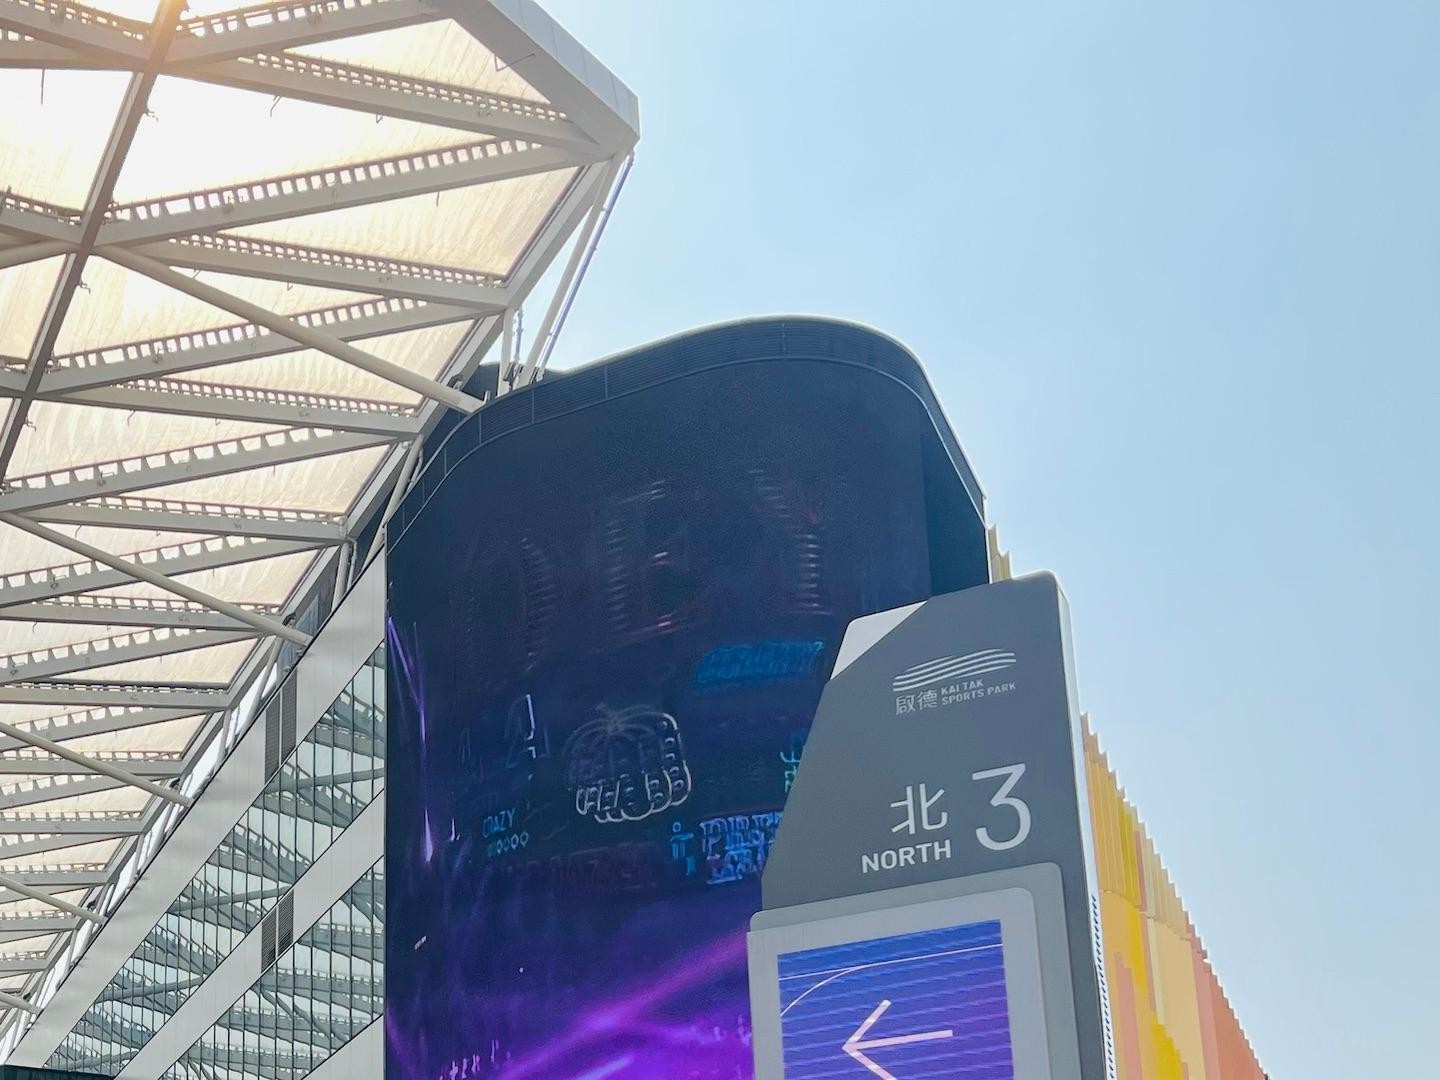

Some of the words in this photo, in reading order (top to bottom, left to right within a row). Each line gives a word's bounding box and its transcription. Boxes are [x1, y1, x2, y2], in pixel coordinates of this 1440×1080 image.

[940, 684, 960, 696] KAI
[963, 679, 985, 691] TAK
[941, 688, 985, 706] SPORTS
[987, 681, 1017, 696] PARK
[889, 782, 949, 835] 北
[971, 762, 1032, 851] 3
[861, 839, 952, 874] NORTH
